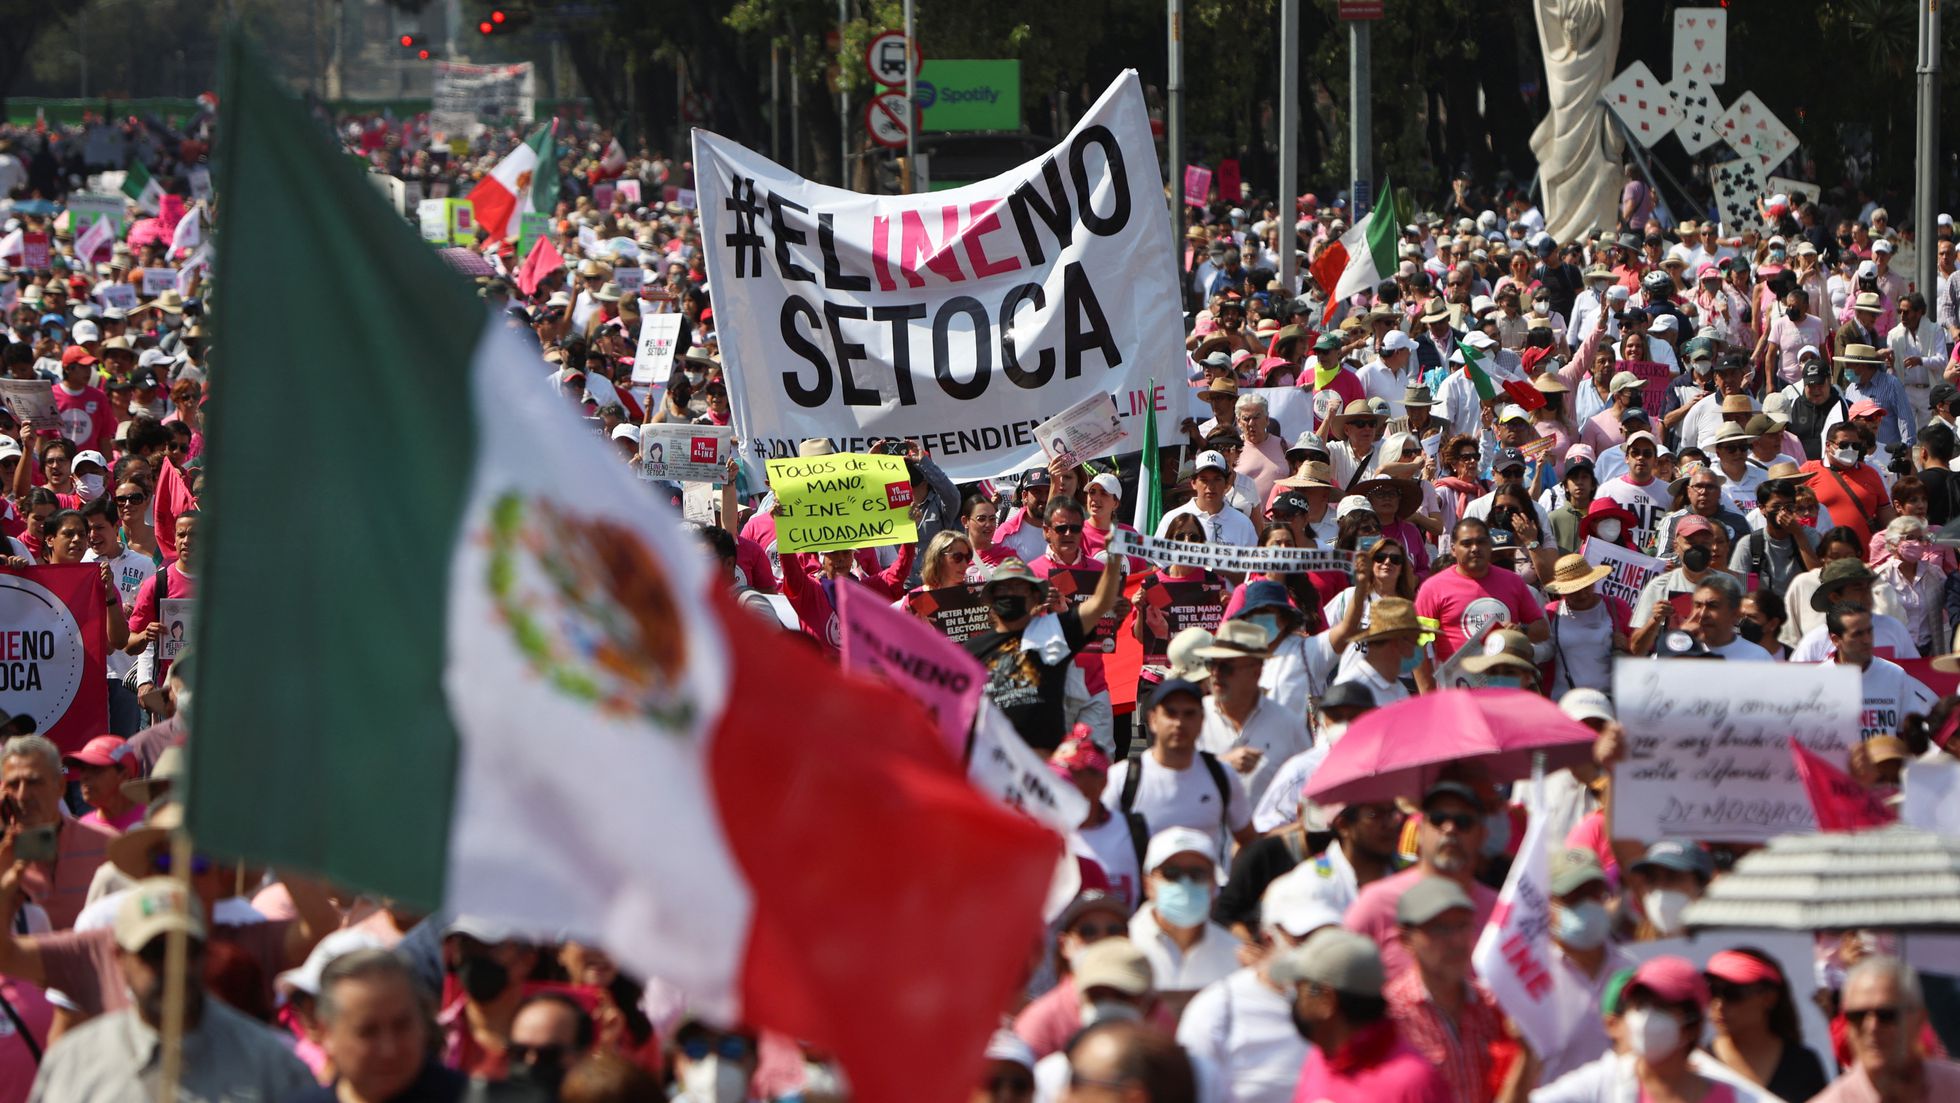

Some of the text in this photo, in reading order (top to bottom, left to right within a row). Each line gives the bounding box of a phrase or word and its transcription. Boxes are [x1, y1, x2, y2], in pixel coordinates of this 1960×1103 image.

[941, 85, 1001, 105] Spotify
[725, 124, 1132, 292] #ELINENO
[780, 260, 1122, 408] SETOCA
[845, 459, 870, 471] de
[878, 459, 900, 472] la
[863, 497, 887, 512] es
[1633, 495, 1650, 505] SIN
[788, 518, 894, 544] CIUDADANO
[1127, 545, 1351, 573] QUE EL PEJE Y MORENA JUNTOS
[1214, 547, 1232, 556] ES
[1274, 549, 1328, 560] FUERTE
[122, 566, 144, 581] AERO
[938, 605, 990, 619] METER MANO
[1170, 604, 1222, 614] METER MANO
[945, 619, 956, 627] EN
[957, 617, 967, 625] EL
[1178, 613, 1190, 622] EN
[1190, 613, 1200, 622] EL
[946, 622, 991, 635] ELECTORAL
[1501, 931, 1555, 1004] INE
